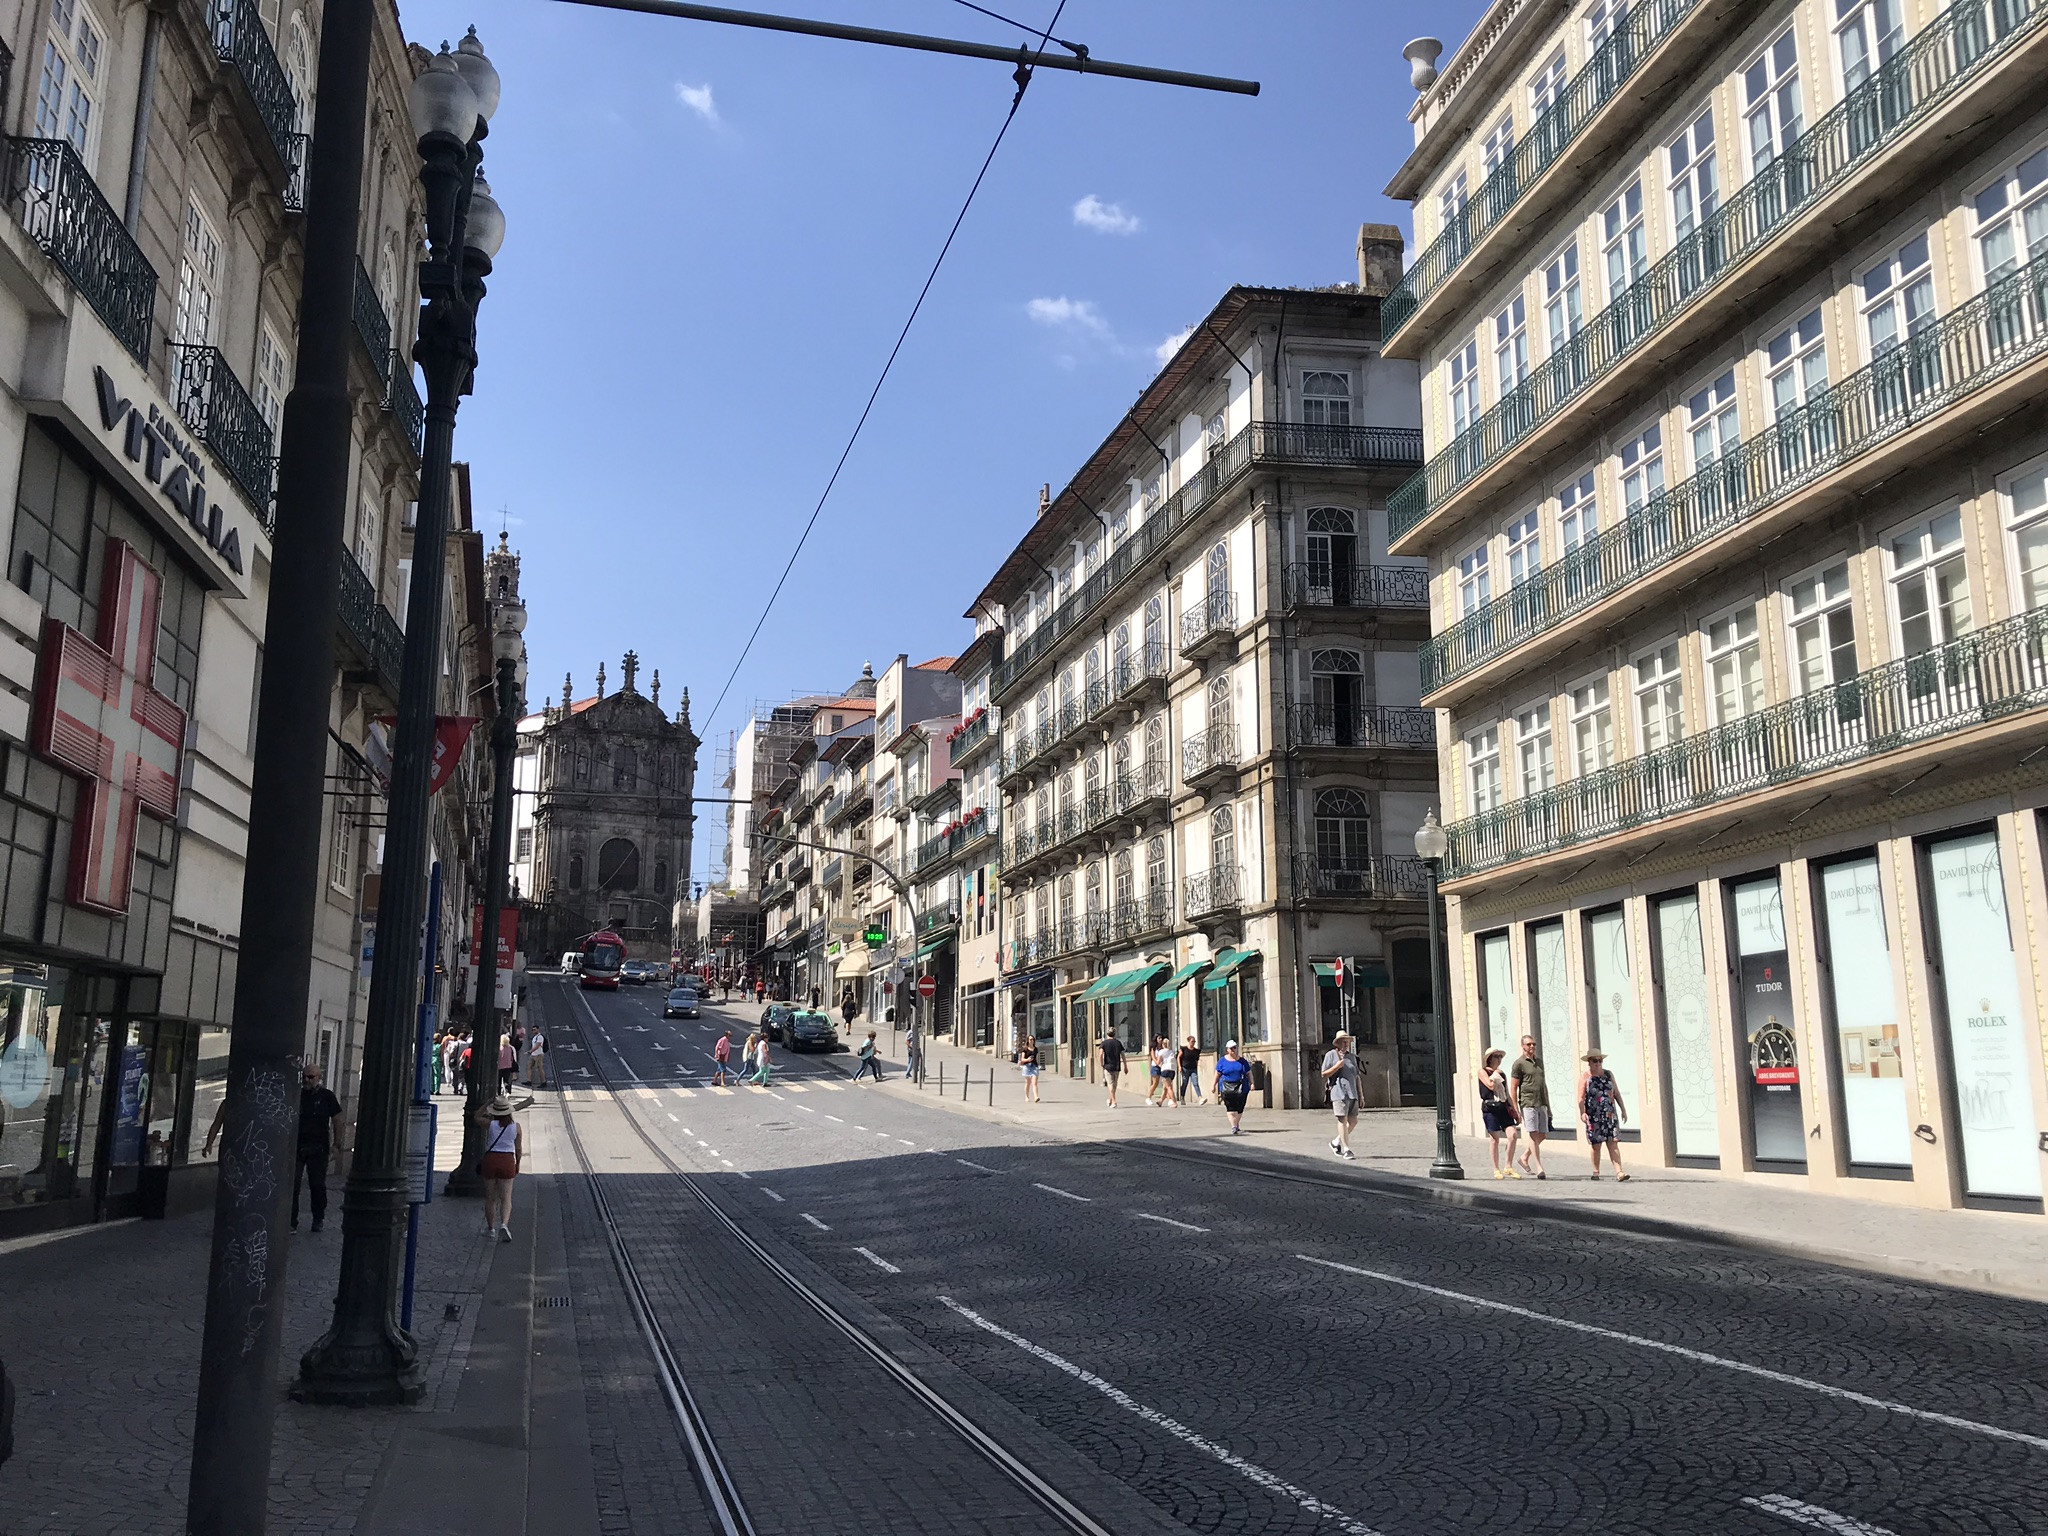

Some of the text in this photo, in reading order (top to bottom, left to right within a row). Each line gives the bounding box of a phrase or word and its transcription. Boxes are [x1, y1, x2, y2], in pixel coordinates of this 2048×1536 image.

[1940, 866, 1968, 881] DAVID
[1831, 887, 1855, 900] DAVID
[1741, 904, 1761, 917] DAVID
[1755, 982, 1783, 993] TUDOR
[1968, 1015, 2007, 1028] ROLEX
